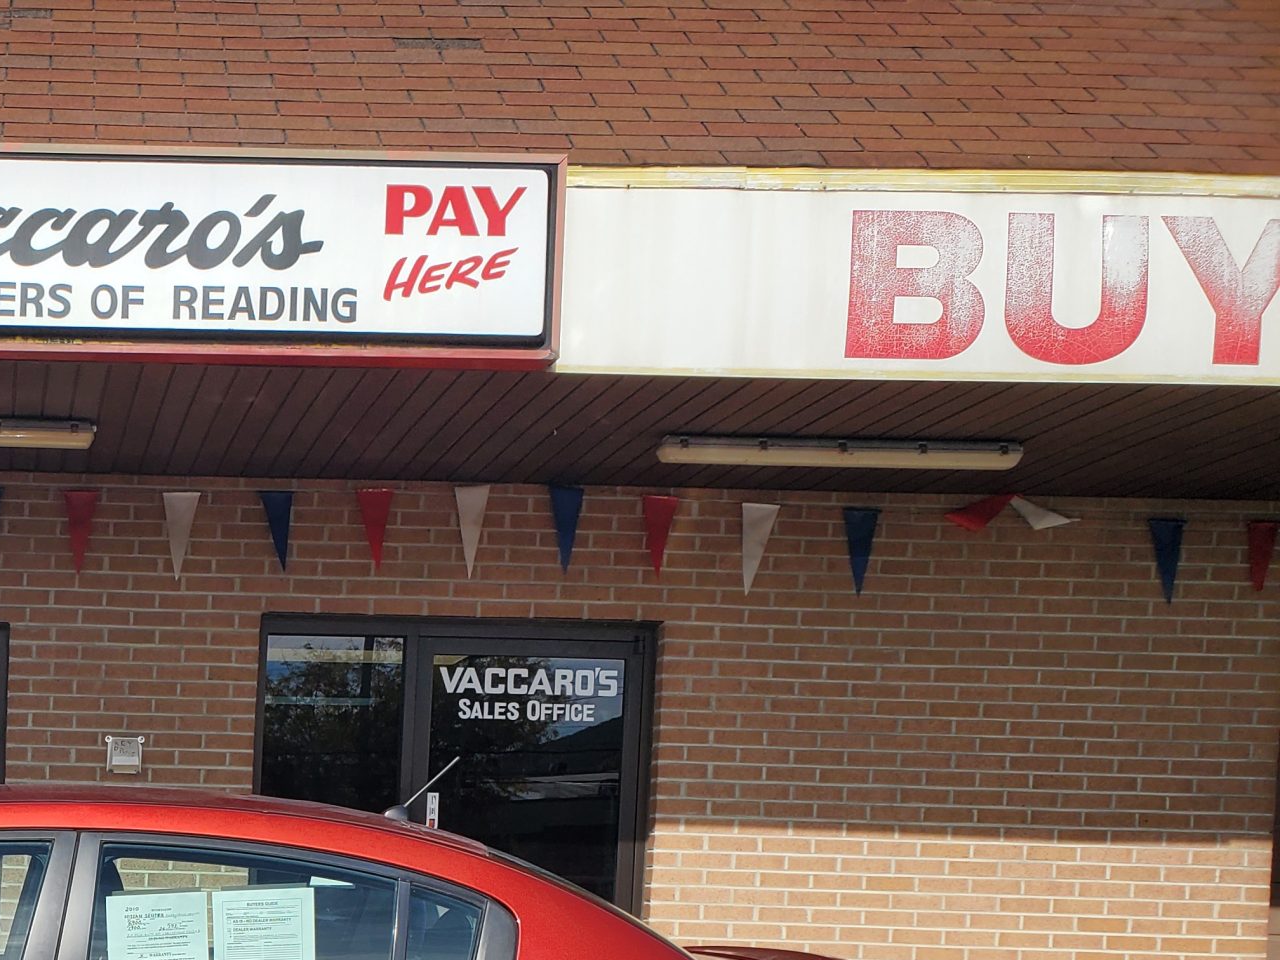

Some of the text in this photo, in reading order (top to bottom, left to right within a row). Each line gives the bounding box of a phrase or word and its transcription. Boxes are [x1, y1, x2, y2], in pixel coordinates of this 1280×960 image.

[384, 185, 526, 237] PAY
[383, 248, 518, 301] HERE
[844, 209, 1280, 365] BUY
[90, 284, 145, 320] OF
[173, 287, 358, 324] READING
[439, 666, 618, 697] VACCARO'S
[458, 698, 595, 722] SALES OFFICE
